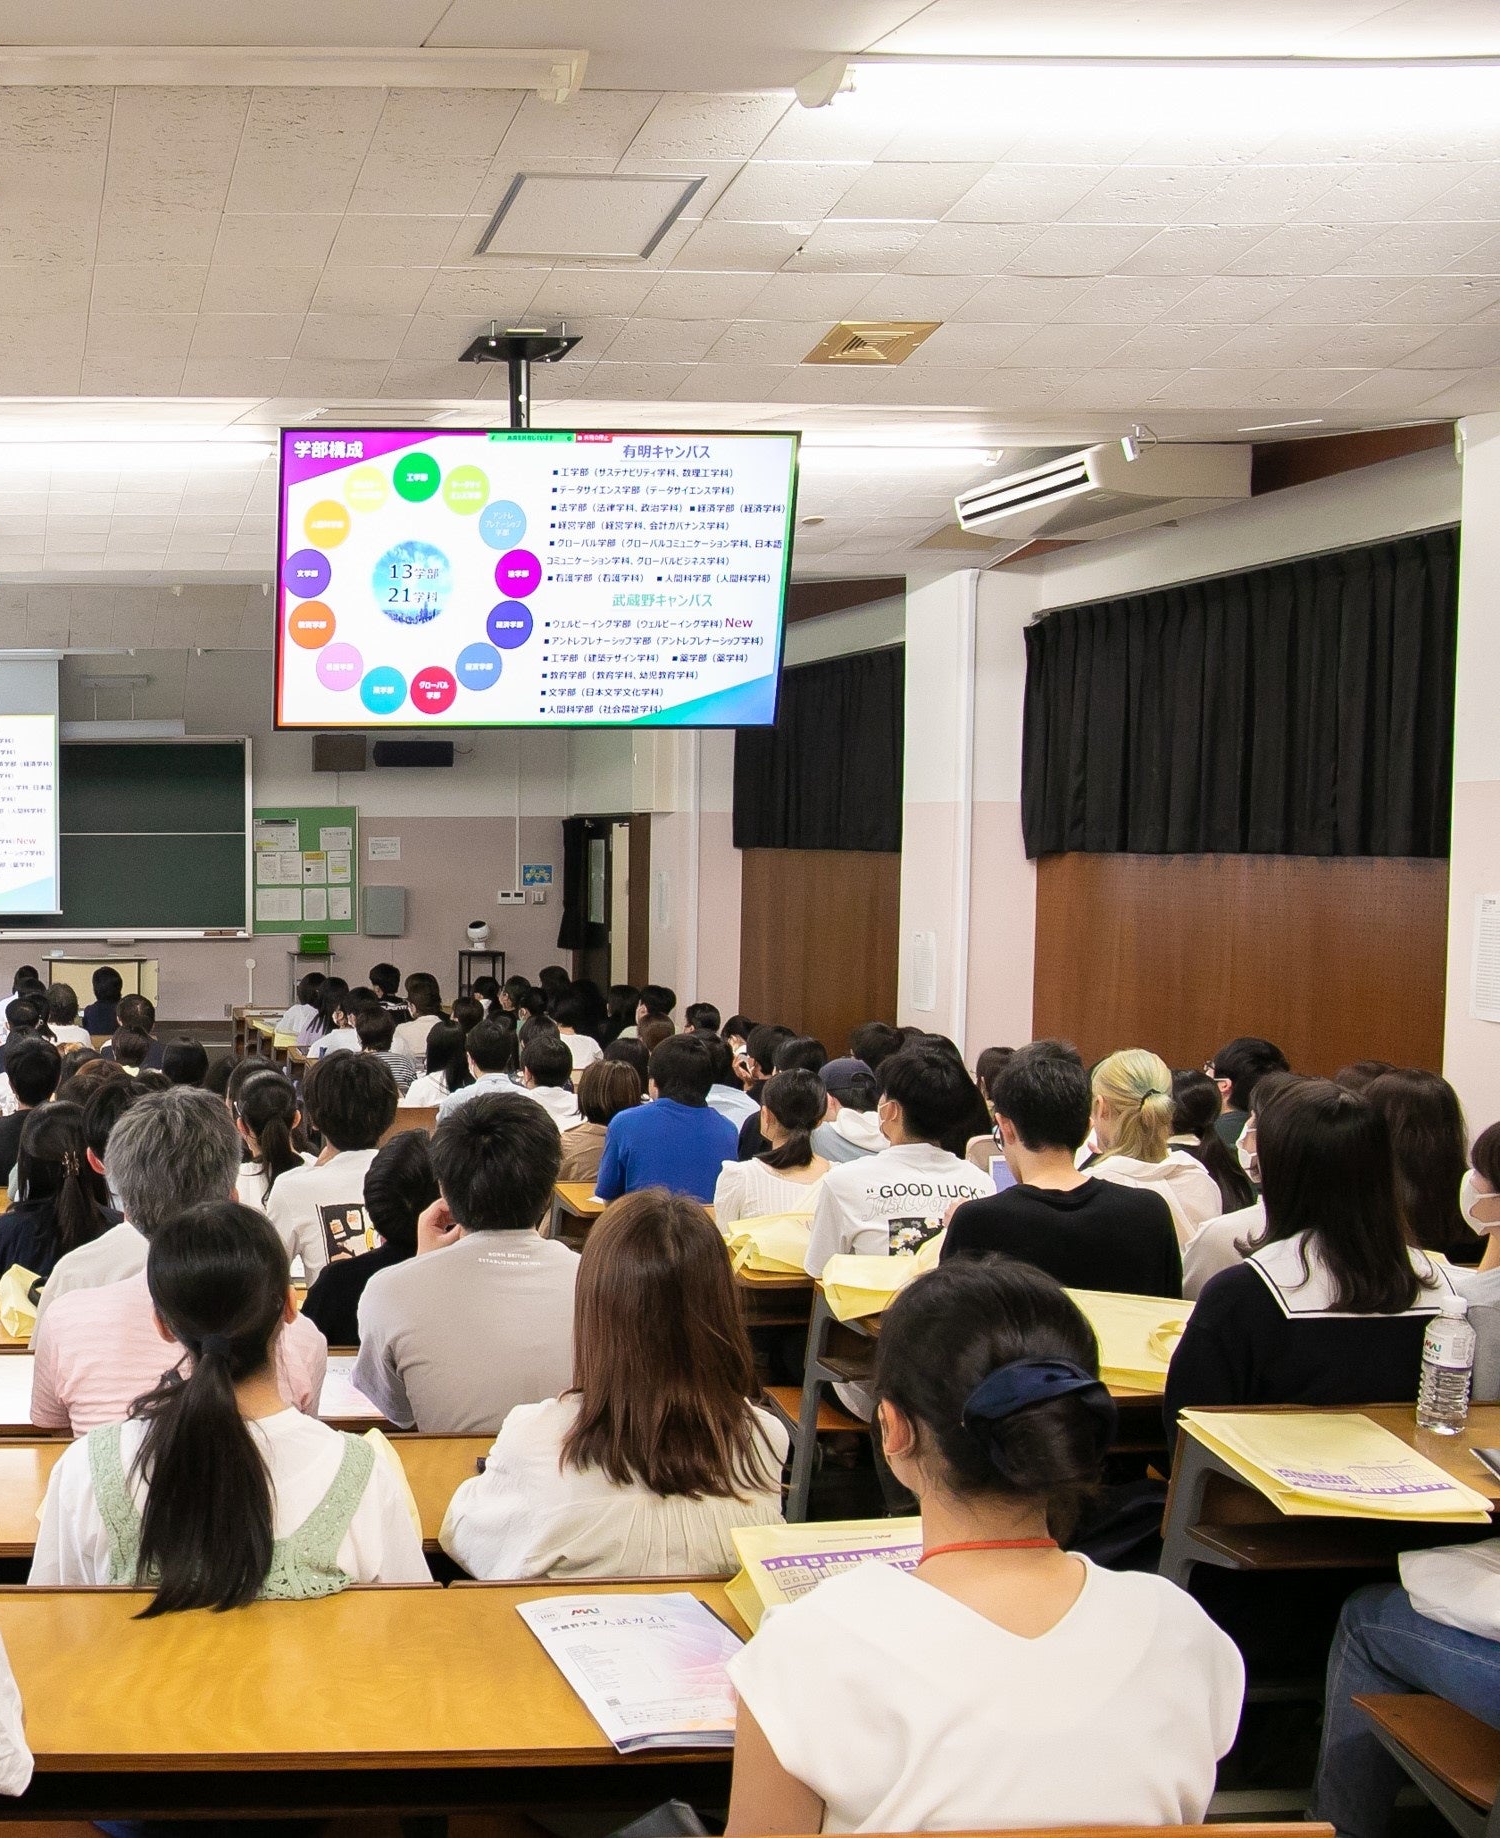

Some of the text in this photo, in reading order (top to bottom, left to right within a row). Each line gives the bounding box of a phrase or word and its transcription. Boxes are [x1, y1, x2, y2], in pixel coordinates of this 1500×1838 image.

[293, 440, 364, 459] 学部構成
[623, 444, 711, 459] 有明キャンパス
[559, 503, 786, 514] 法学部（法律学科、政治学科） 経済学部（経済学科）
[665, 573, 771, 583] 人間科学部（人間科学科）
[612, 594, 713, 608] 武蔵野キャンパス
[725, 618, 753, 629] New
[549, 688, 664, 698] 文学部（日本文学文化学科）
[548, 705, 662, 715] 人間科学部（社会福祉学科）
